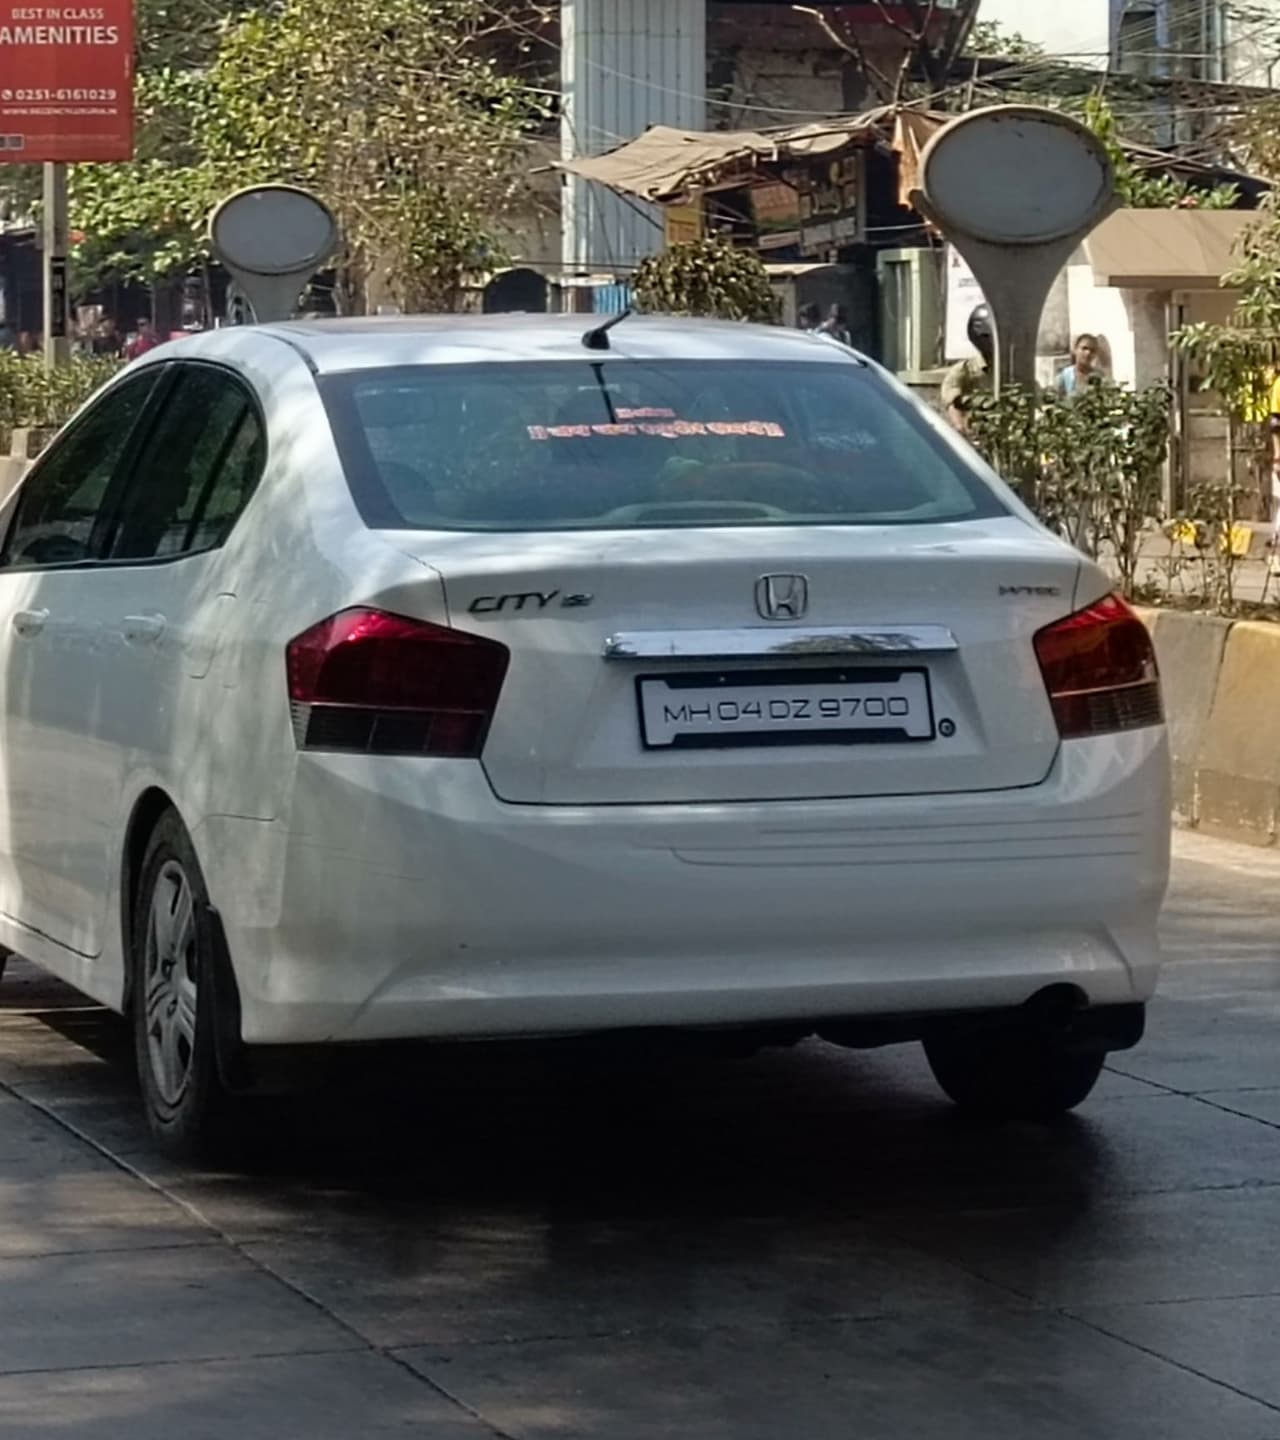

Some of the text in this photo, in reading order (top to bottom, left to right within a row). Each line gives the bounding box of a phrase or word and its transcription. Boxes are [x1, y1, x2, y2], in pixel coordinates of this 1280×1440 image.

[11, 8, 104, 20] BEST IN CLASS
[467, 589, 560, 613] CITY
[663, 696, 909, 724] MH 04 DZ 9700
